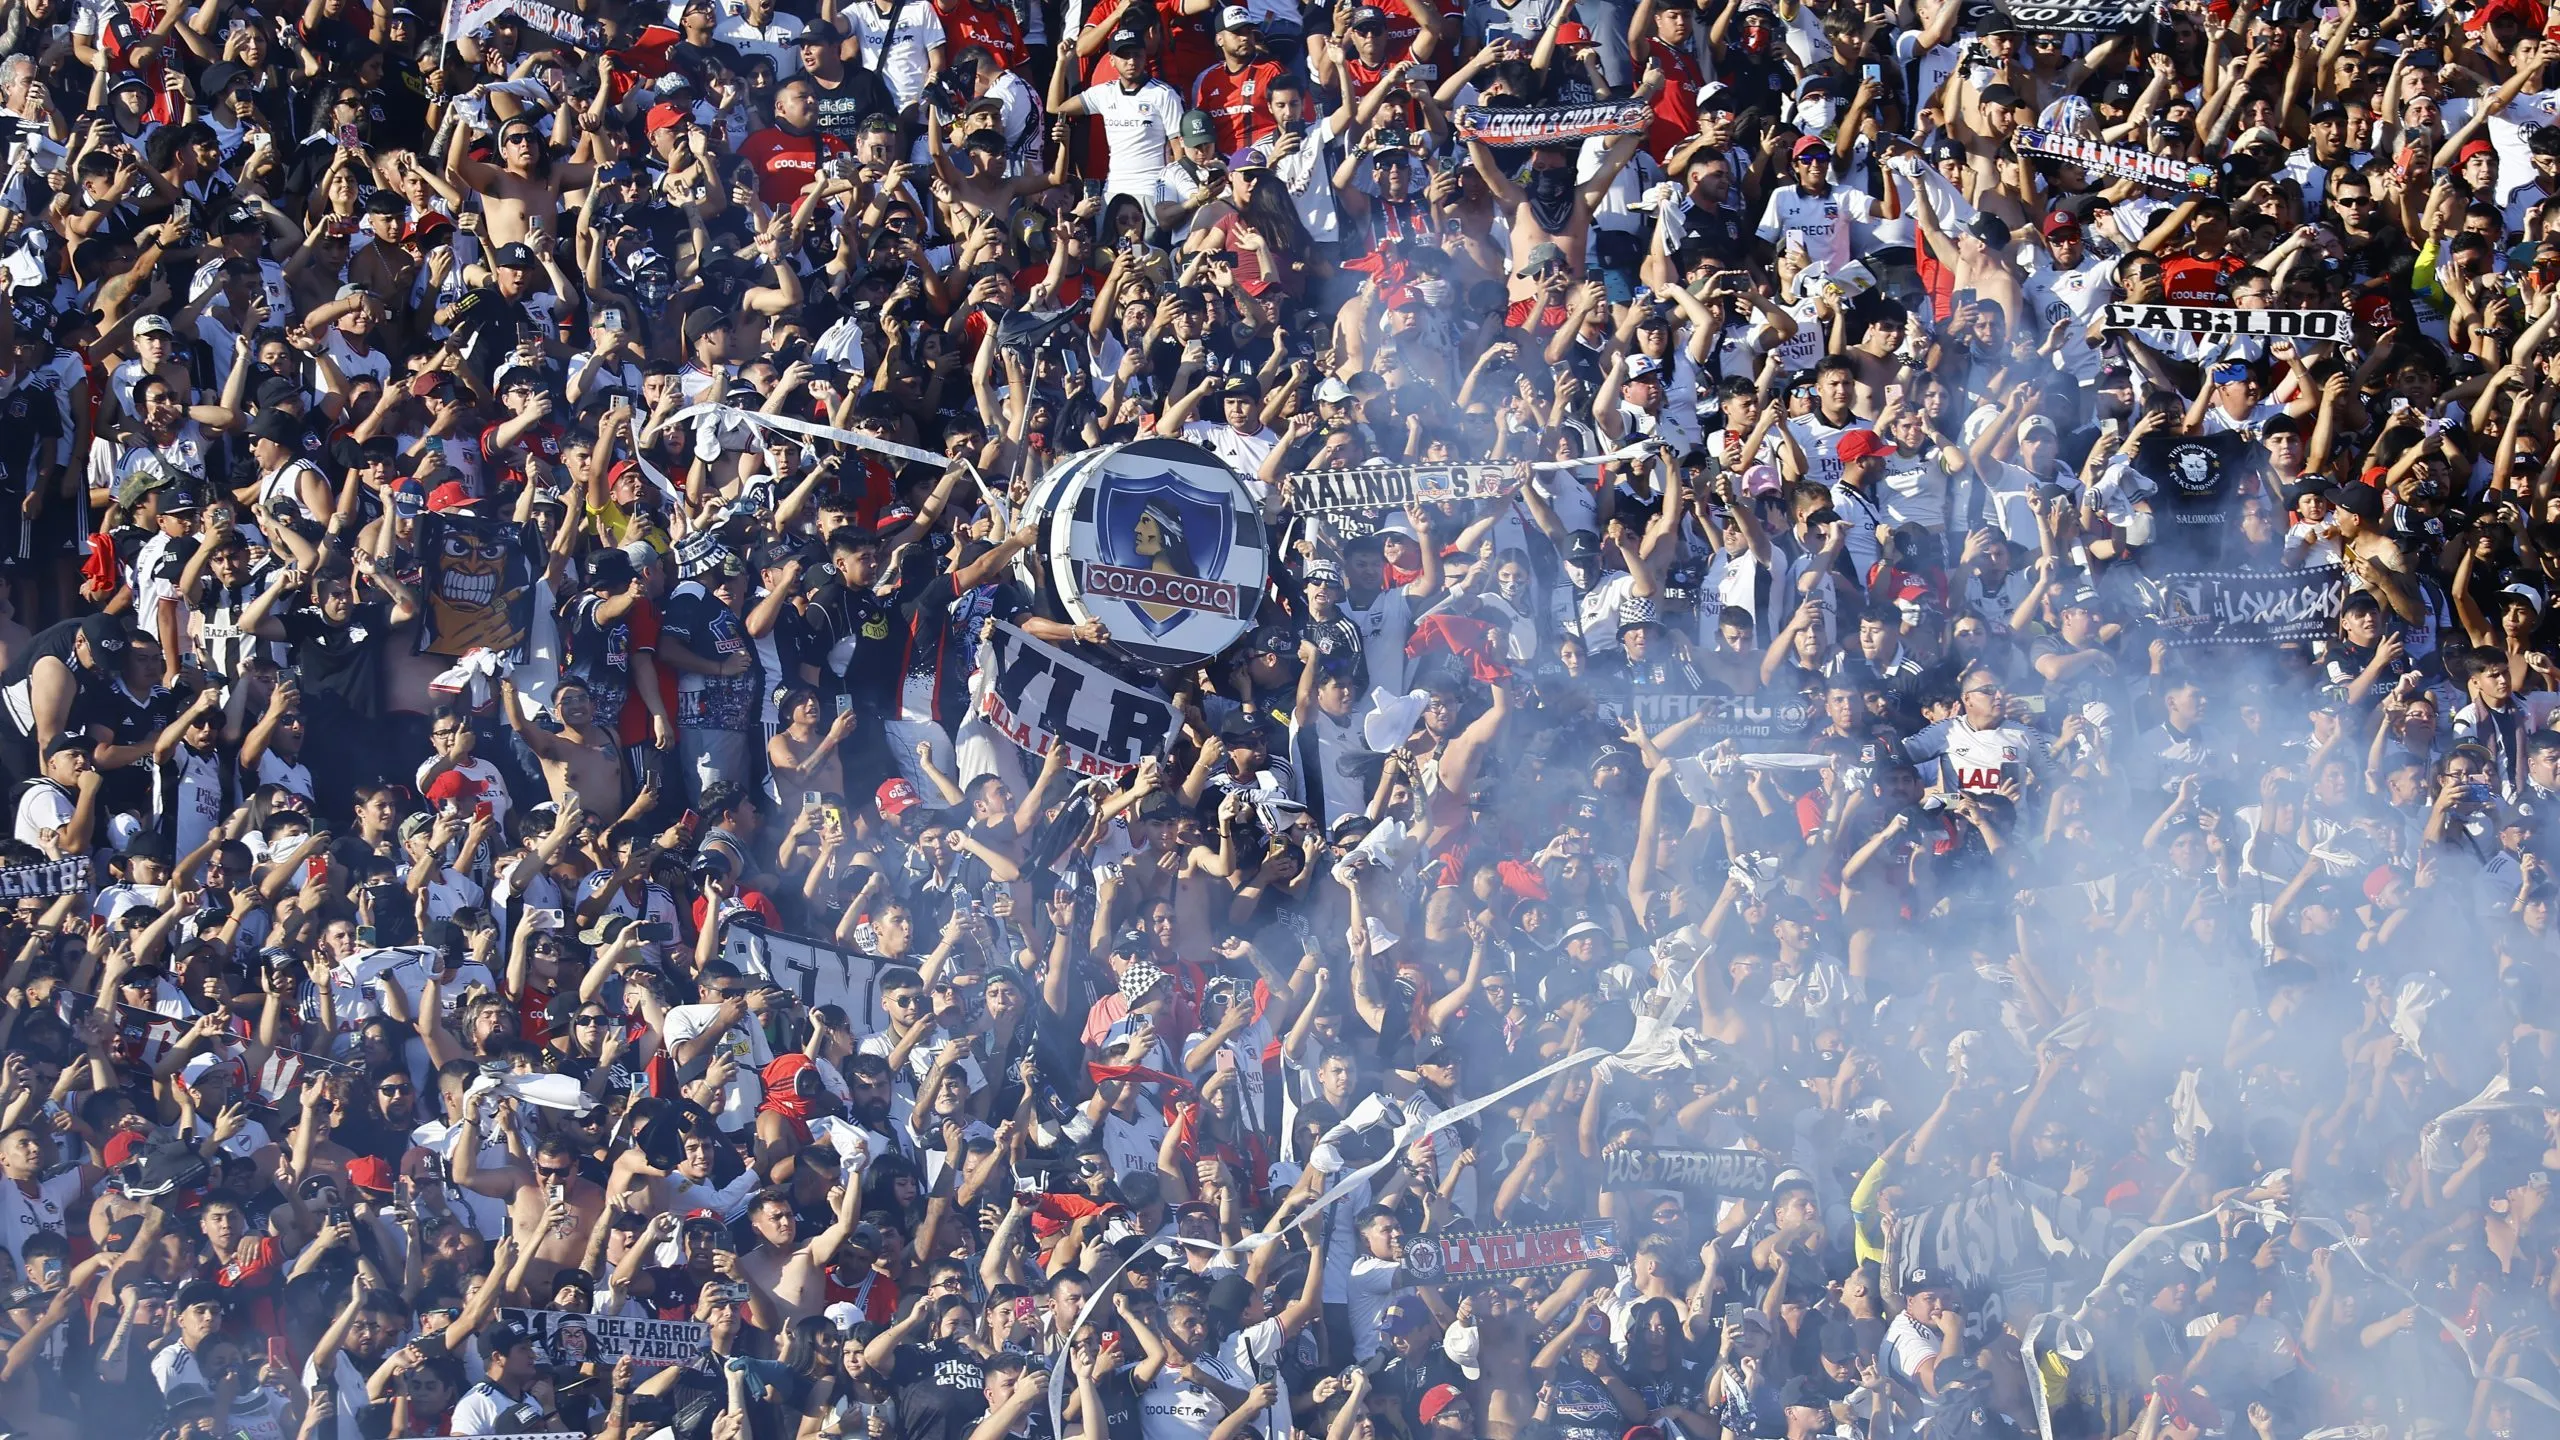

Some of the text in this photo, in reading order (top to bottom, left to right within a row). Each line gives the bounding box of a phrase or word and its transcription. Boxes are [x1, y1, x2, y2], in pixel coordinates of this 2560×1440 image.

[2055, 9, 2143, 25] JOHN
[818, 99, 855, 113] didas
[2044, 134, 2187, 183] GRANEROS
[515, 246, 526, 259] NY
[2171, 290, 2215, 301] COOLBET
[1791, 344, 1816, 360] Sur
[1090, 568, 1231, 610] COLO-COLO
[205, 626, 228, 638] RAZA
[1606, 1149, 1643, 1185] LOS
[1440, 1228, 1587, 1274] LA VELASKE
[597, 1318, 700, 1343] DEL BARRIO
[601, 1337, 624, 1355] AL
[936, 1375, 955, 1386] del
[1145, 1405, 1190, 1417] COOLBET
